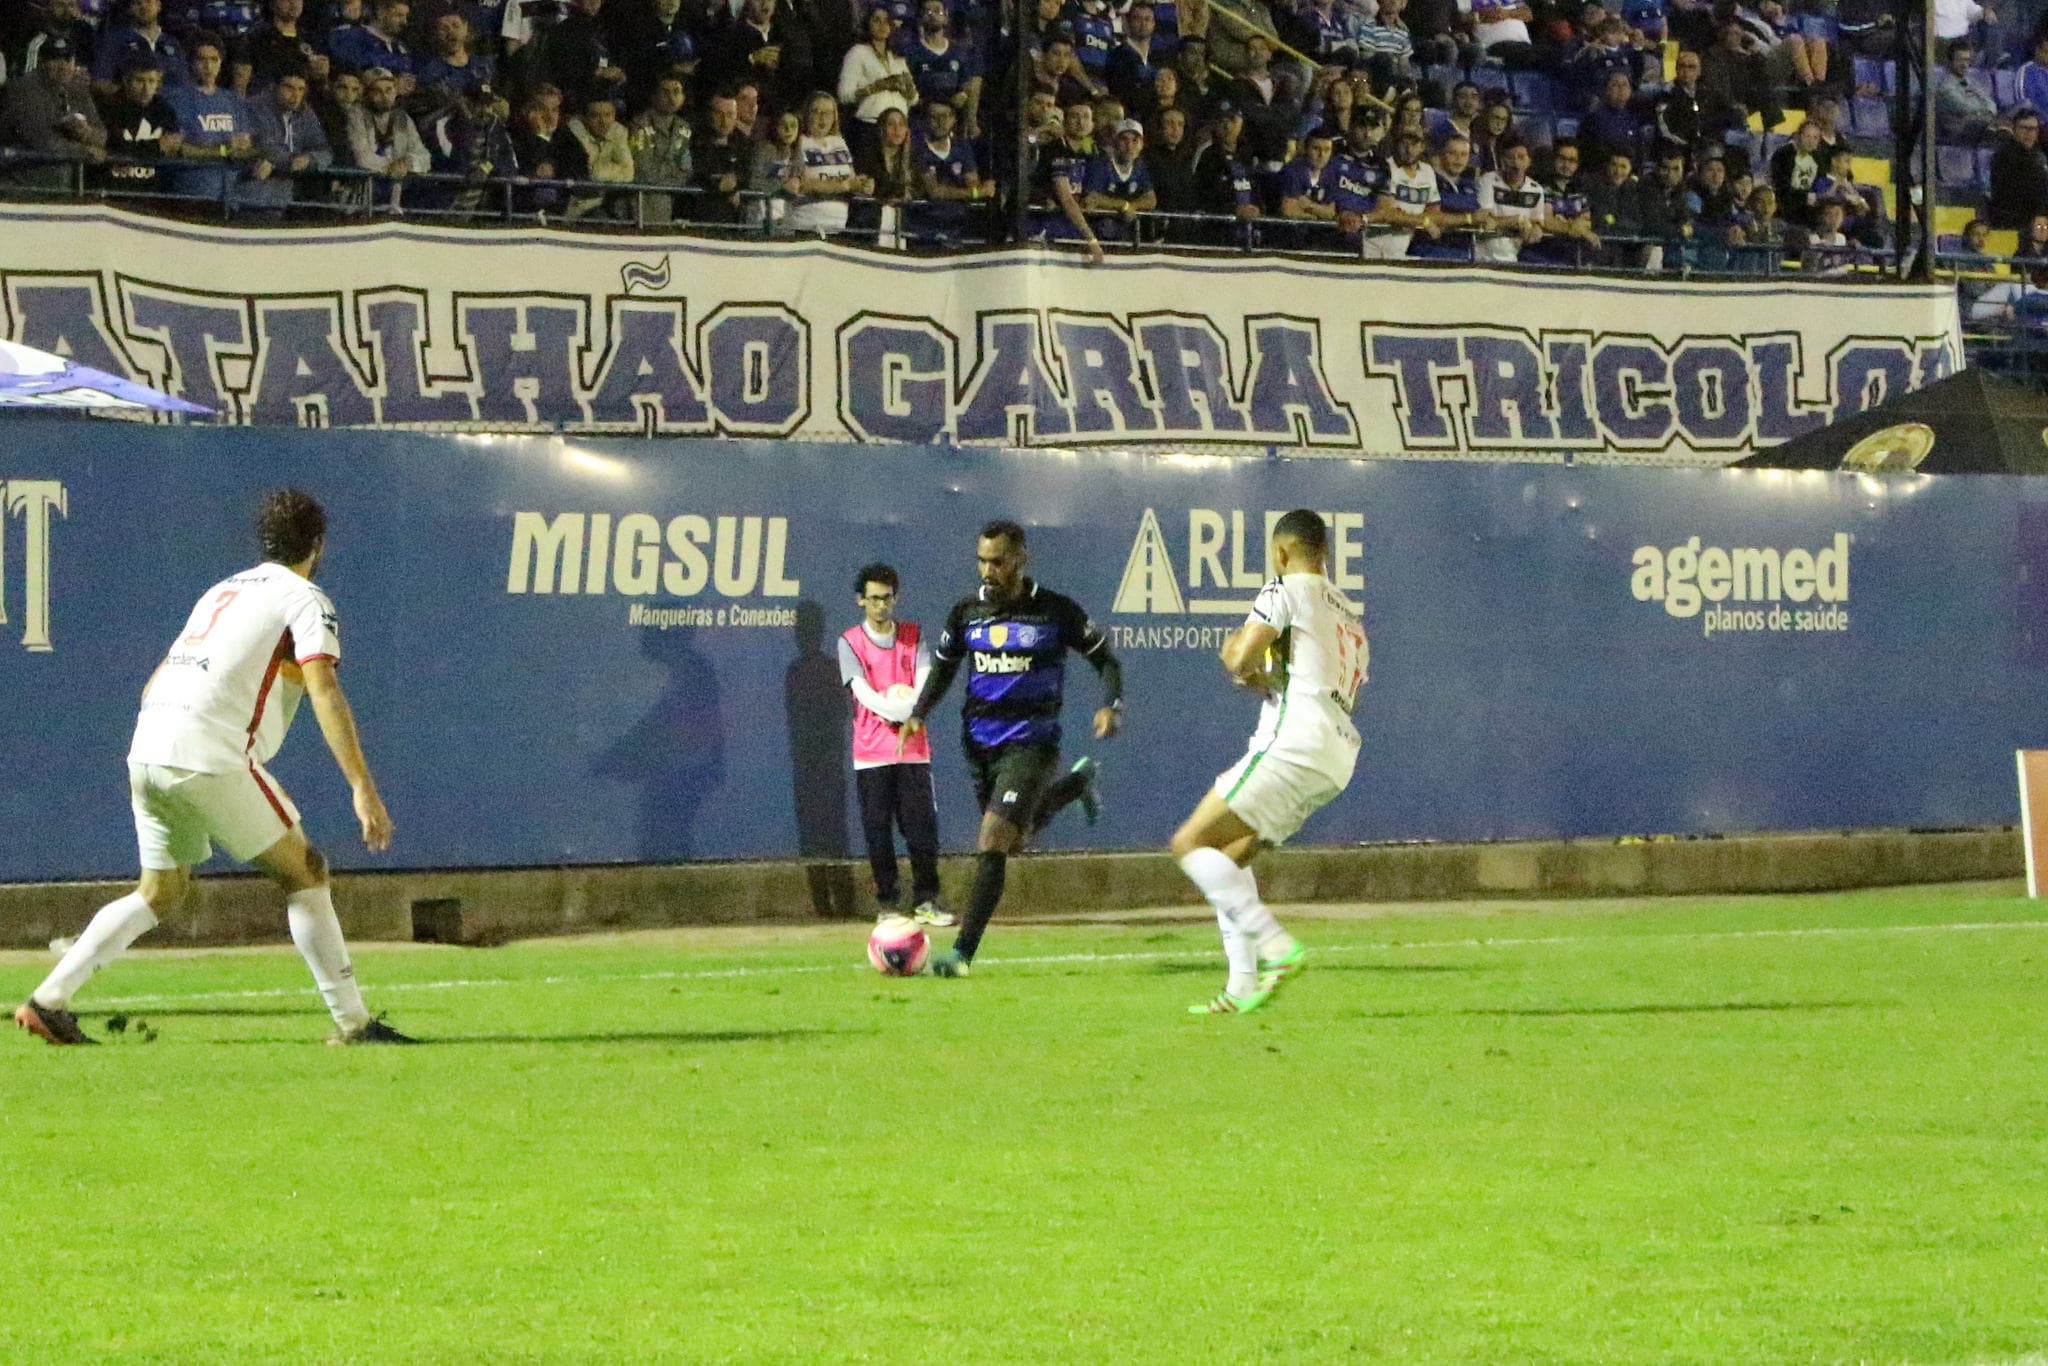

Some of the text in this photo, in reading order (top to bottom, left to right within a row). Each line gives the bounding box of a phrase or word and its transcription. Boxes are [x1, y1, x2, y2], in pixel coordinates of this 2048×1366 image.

[198, 114, 233, 132] VANS
[836, 308, 1361, 450] GARRA
[507, 511, 800, 596] MIGSUL
[1631, 532, 1849, 617] agemed
[629, 604, 798, 630] Mangueiras e Conexões
[1704, 603, 1848, 636] planos de saúde
